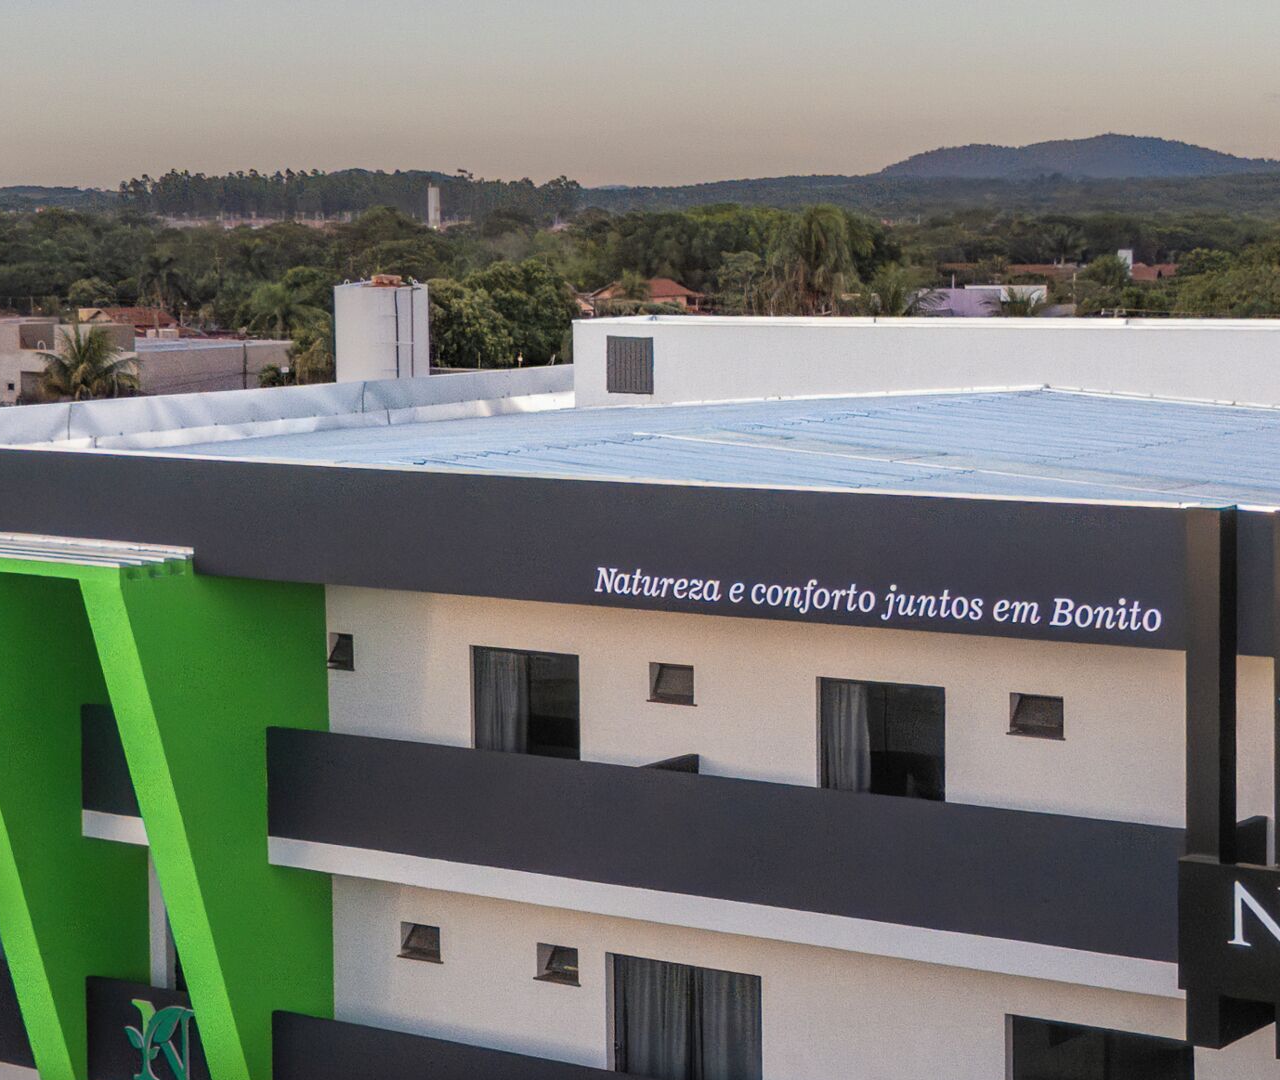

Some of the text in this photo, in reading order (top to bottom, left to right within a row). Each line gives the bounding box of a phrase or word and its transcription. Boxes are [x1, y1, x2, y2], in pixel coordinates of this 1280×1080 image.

[594, 566, 1163, 633] Natureza e conforto juntos em Bonito
